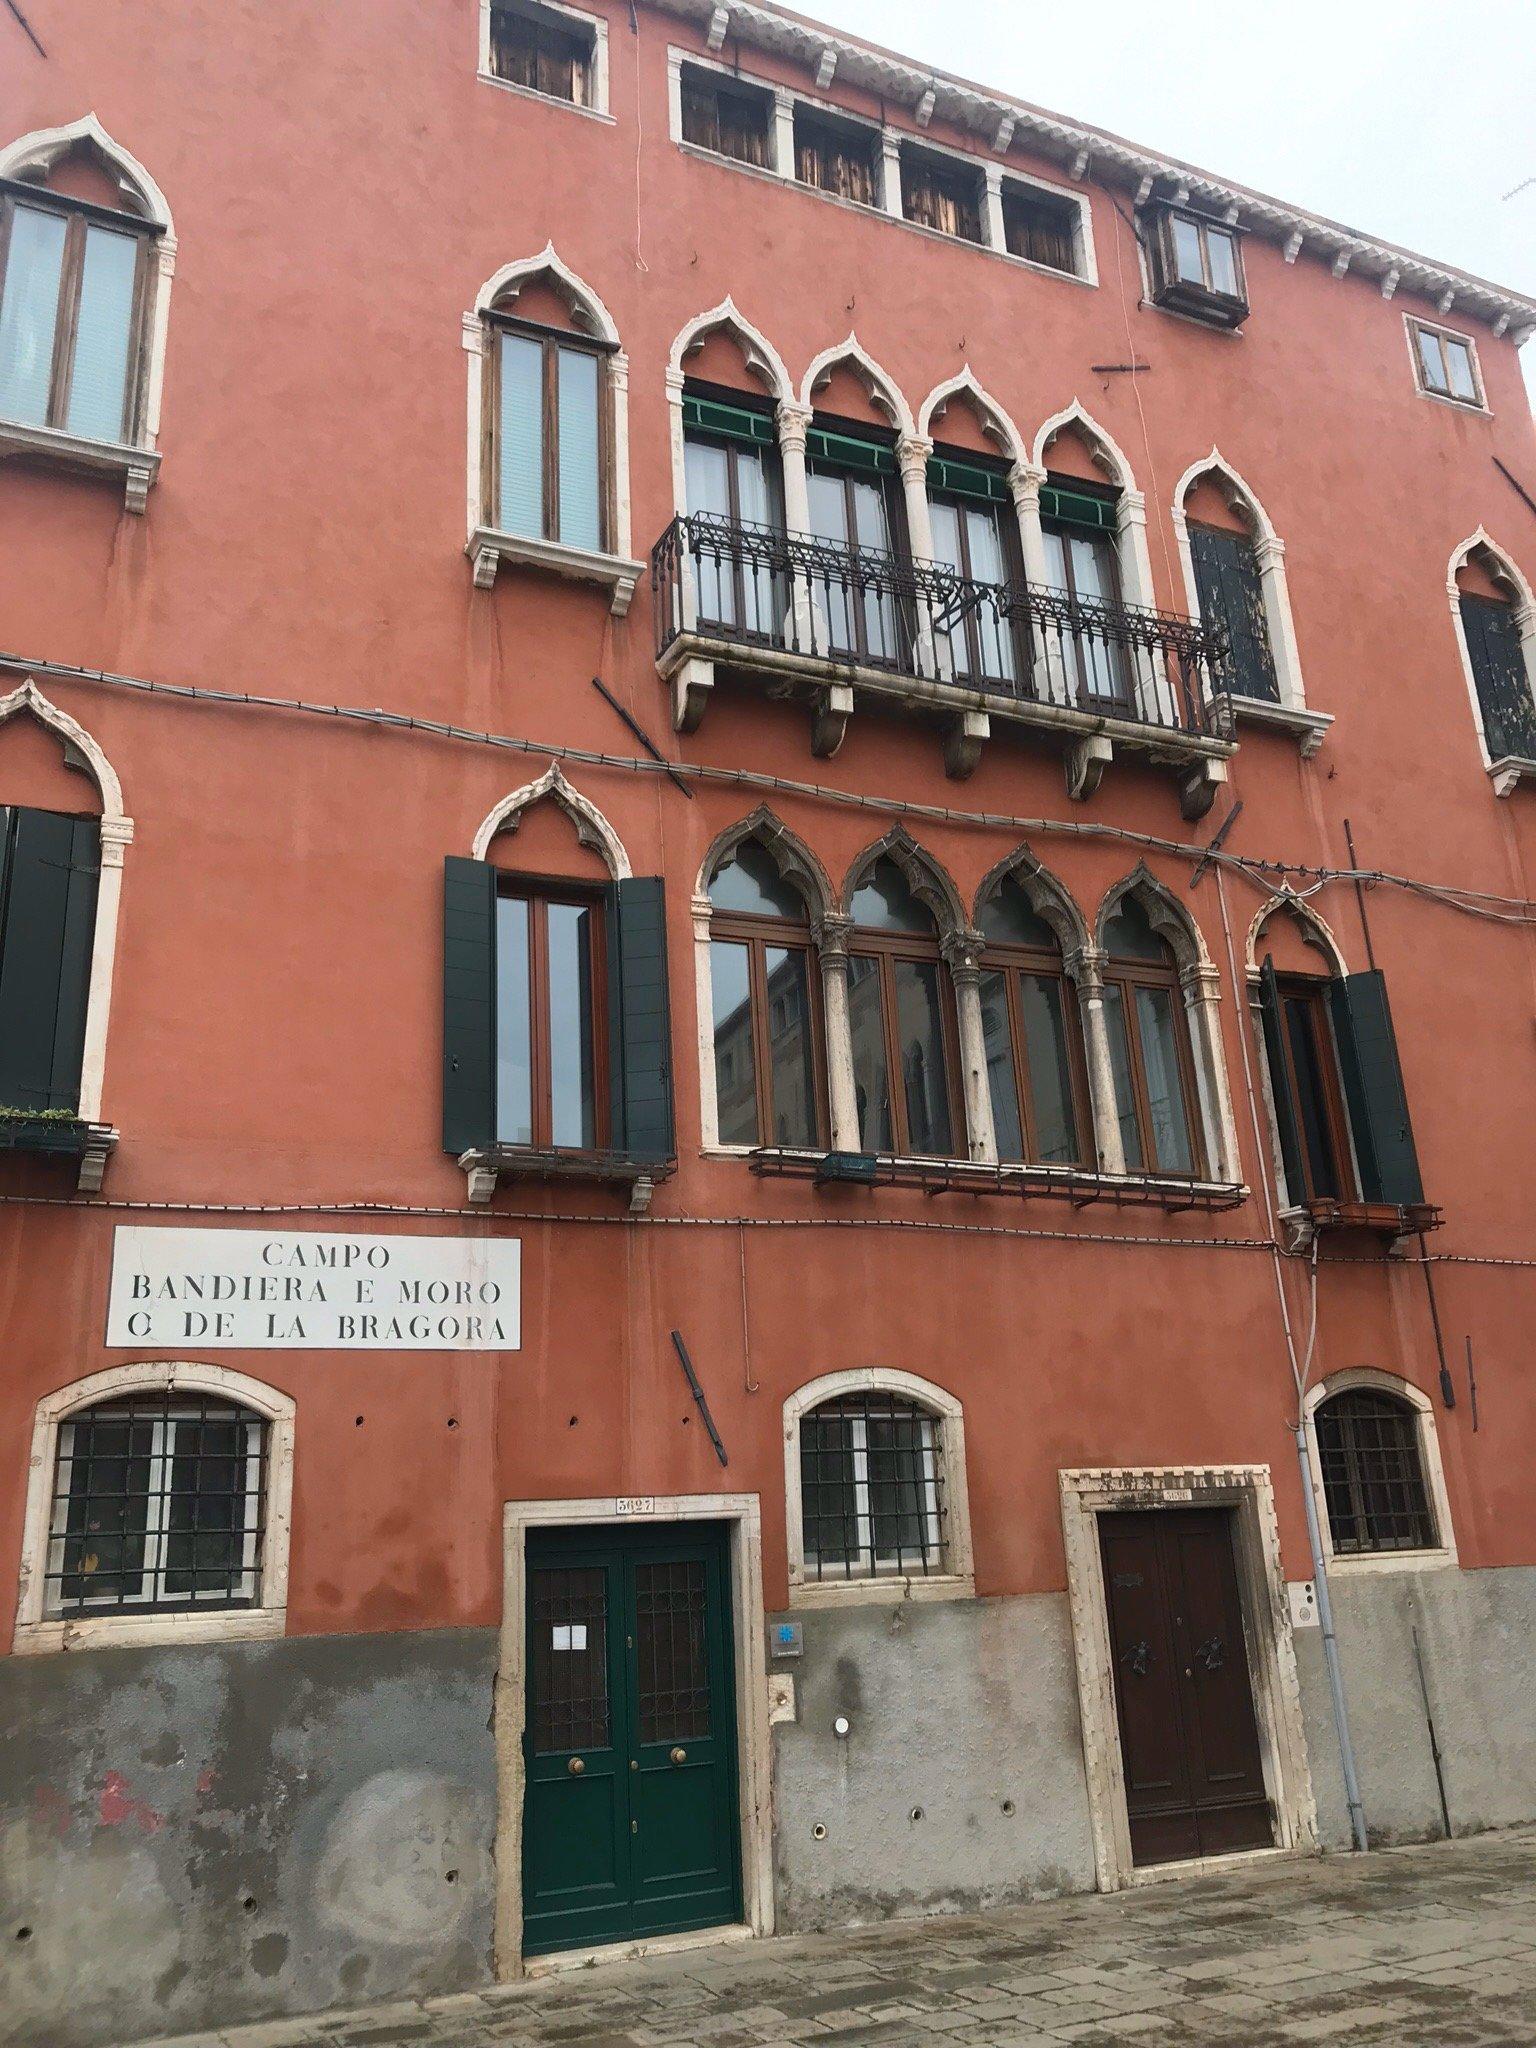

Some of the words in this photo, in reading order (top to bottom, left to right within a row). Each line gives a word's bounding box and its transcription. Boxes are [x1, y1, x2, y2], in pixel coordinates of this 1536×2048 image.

[262, 1243, 391, 1269] CAMPO
[131, 1274, 328, 1302] BANDIERA
[355, 1279, 374, 1304] E
[398, 1280, 501, 1305] MORO
[183, 1311, 234, 1338] DE
[266, 1313, 307, 1339] LA
[337, 1315, 506, 1340] BRAGORA
[619, 1500, 651, 1511] 5627
